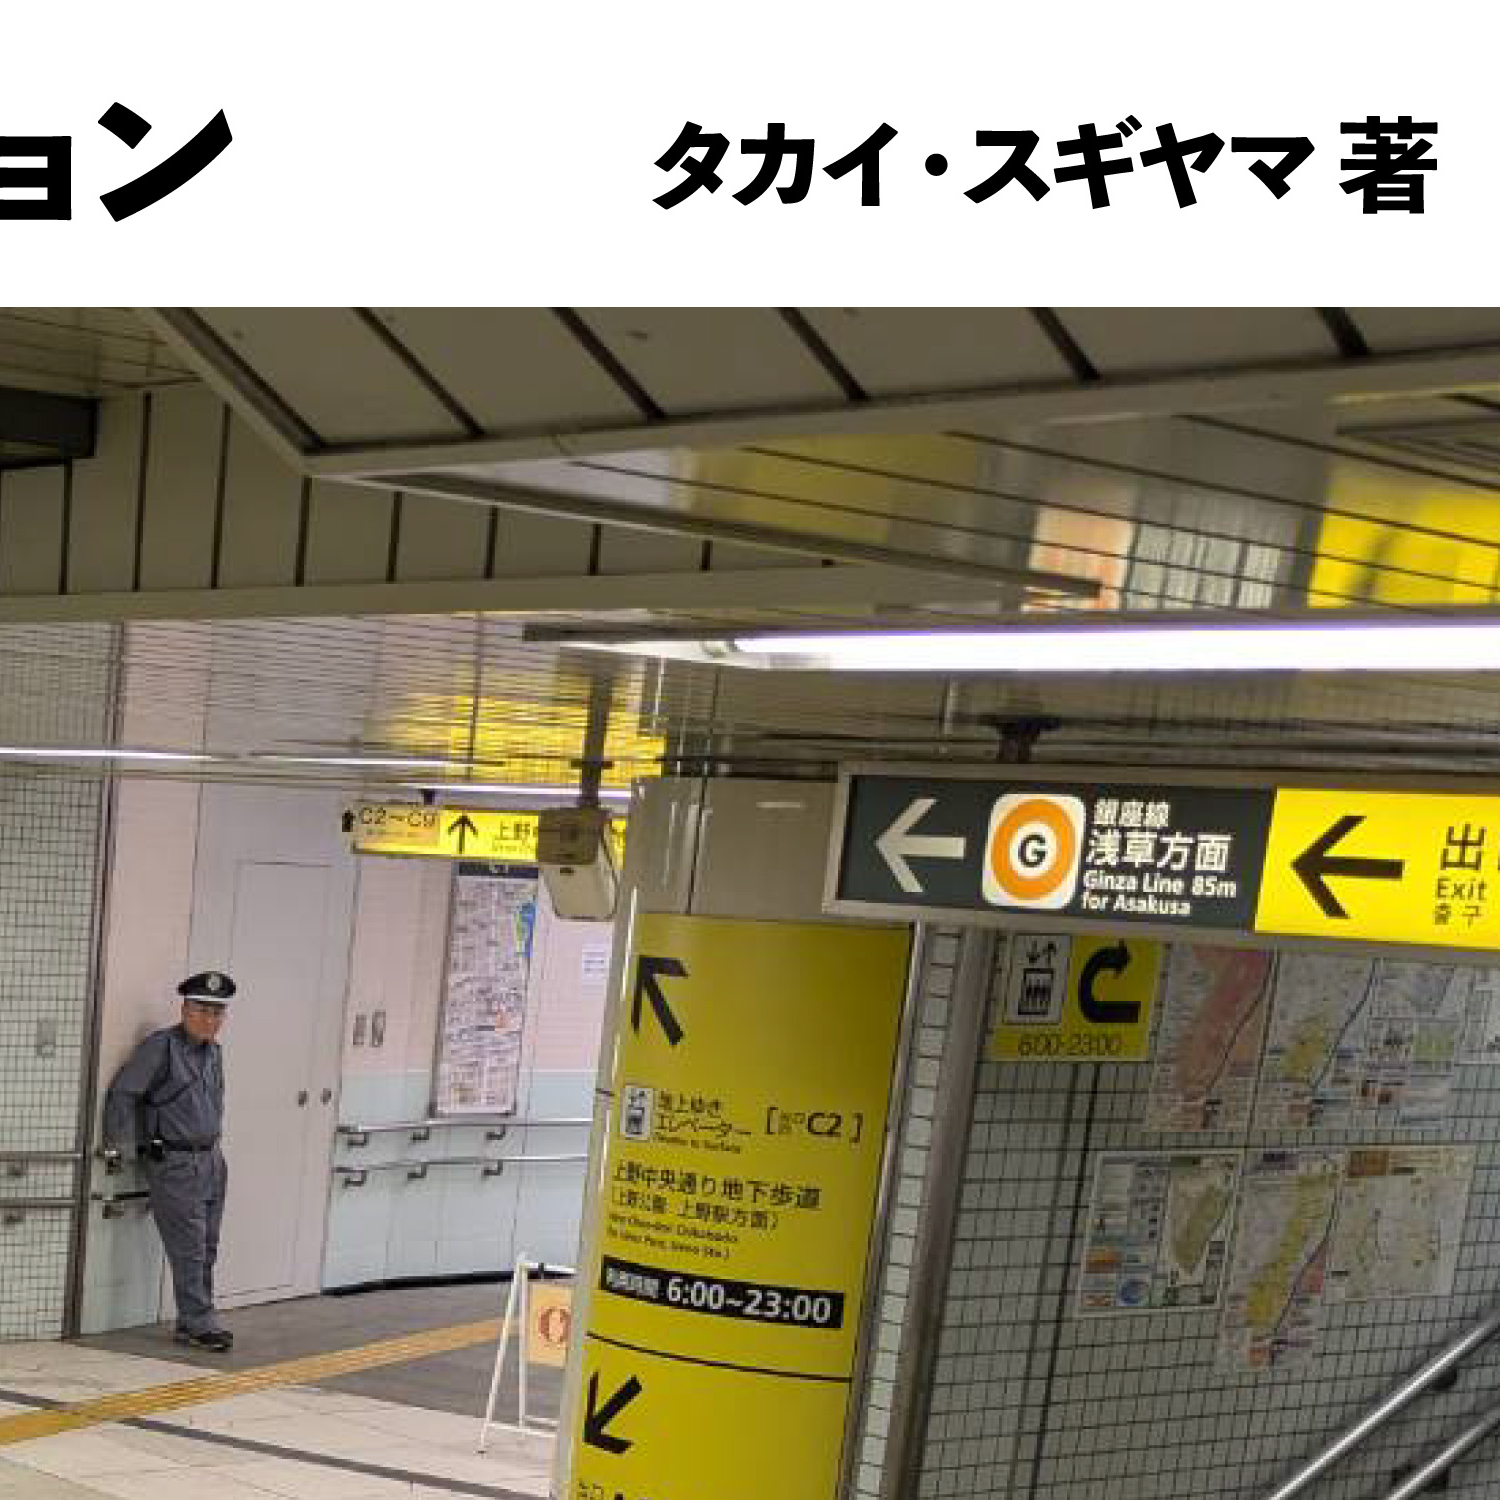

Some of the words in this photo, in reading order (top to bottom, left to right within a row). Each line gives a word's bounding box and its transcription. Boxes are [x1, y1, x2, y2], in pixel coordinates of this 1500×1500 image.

[1093, 798, 1171, 829] 銀座線
[1085, 828, 1234, 872] 浅草方面
[1082, 869, 1139, 891] Ginza
[1142, 872, 1185, 896] Line
[1191, 875, 1238, 899] 85m
[1437, 877, 1487, 901] Exit
[1081, 891, 1109, 910] for
[1112, 894, 1192, 916] Asakusa
